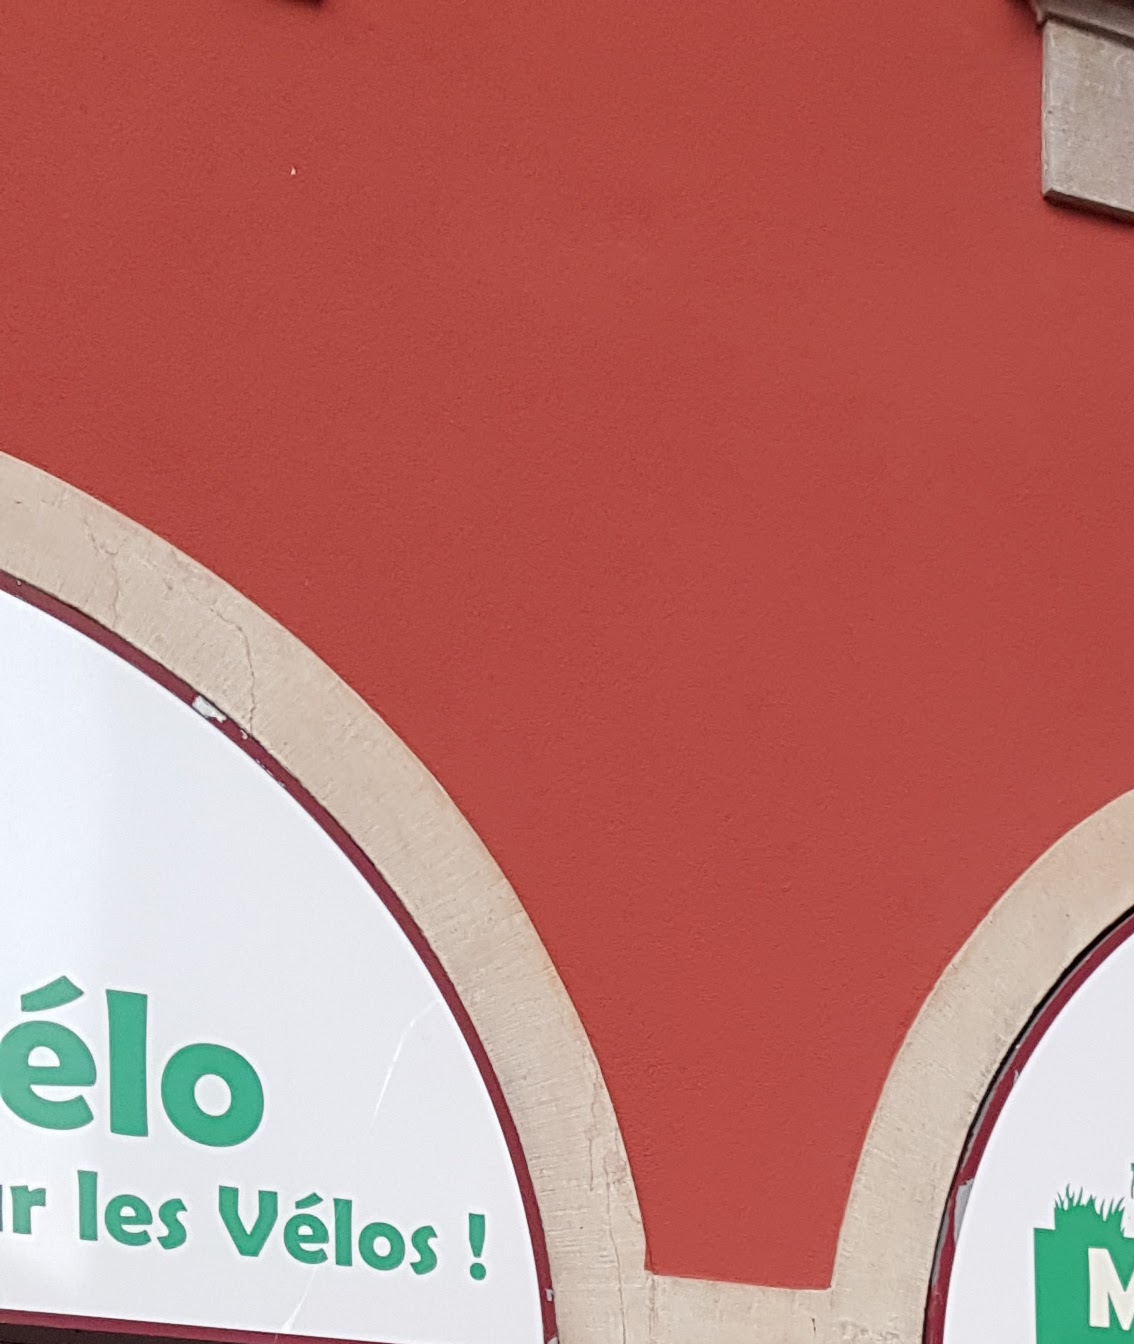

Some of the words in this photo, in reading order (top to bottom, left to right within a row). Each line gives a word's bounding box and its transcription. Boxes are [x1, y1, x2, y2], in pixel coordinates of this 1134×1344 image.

[0, 975, 265, 1148] élo
[0, 1184, 47, 1236] r
[77, 1169, 189, 1251] les
[218, 1185, 439, 1276] Vélos
[468, 1212, 488, 1282] !
